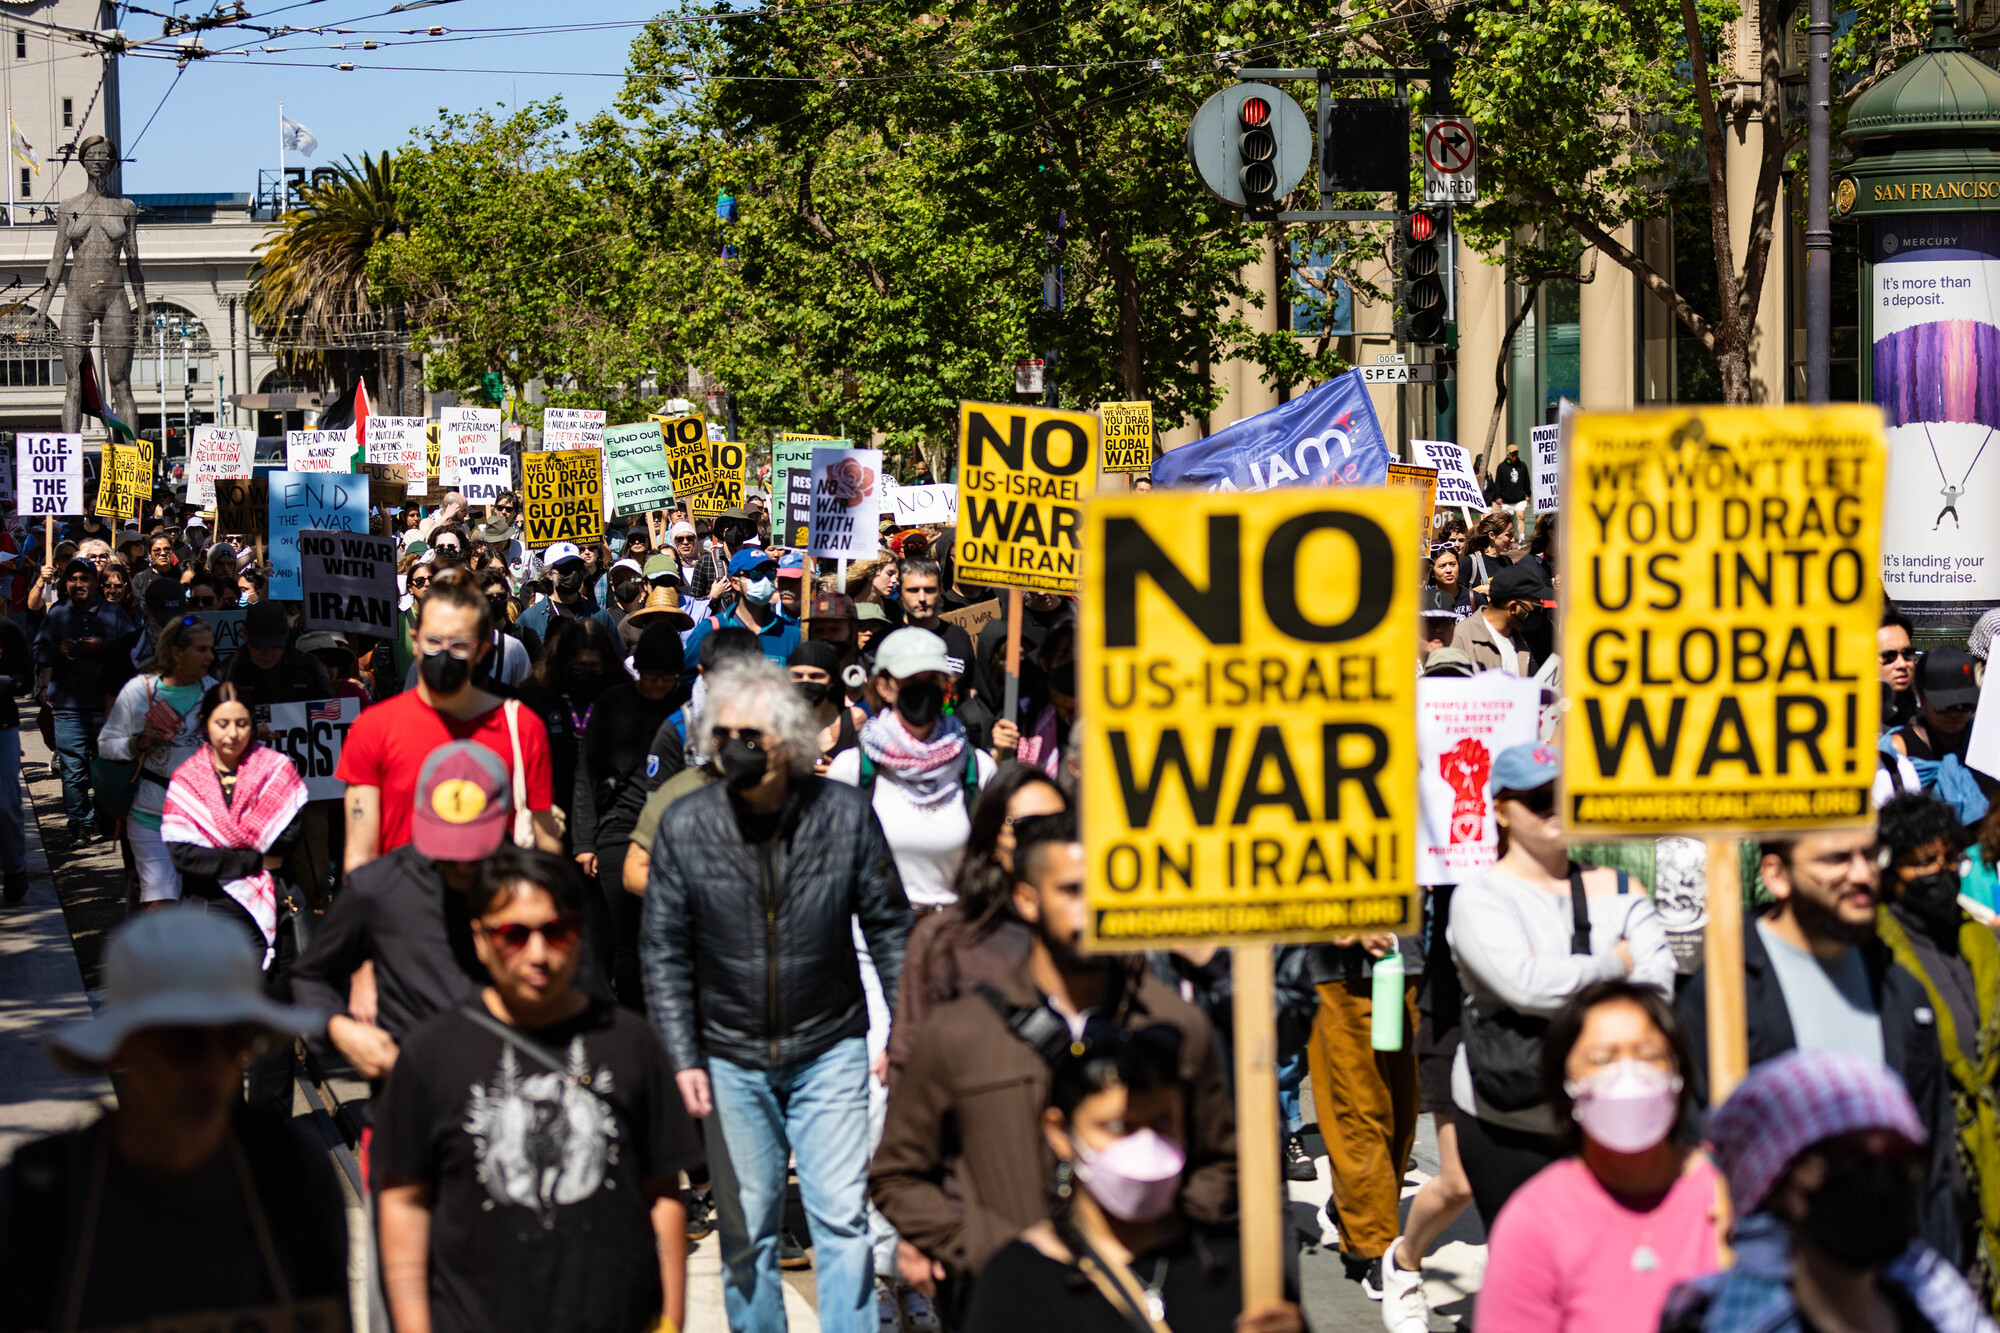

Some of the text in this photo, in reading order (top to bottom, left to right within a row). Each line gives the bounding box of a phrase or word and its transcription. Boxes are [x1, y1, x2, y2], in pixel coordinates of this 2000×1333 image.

[1429, 181, 1472, 194] ON RED
[1874, 182, 2000, 200] SAN FRANCISC
[1902, 238, 1958, 246] MERCURY
[1902, 278, 1936, 289] more
[1941, 276, 1971, 288] than
[1892, 292, 1944, 308] deposit.
[1366, 368, 1418, 380] SPEAR
[462, 410, 480, 421] U.S.
[548, 410, 564, 418] IRAN
[584, 411, 604, 419] RIGHT
[1104, 416, 1149, 424] YOU DRAG
[370, 418, 386, 429] IRAN
[407, 418, 424, 428] RIGHT
[448, 422, 499, 432] IMPERIALISM:
[552, 420, 578, 430] NUCLEAR
[1106, 424, 1149, 436] US INTO
[210, 430, 234, 440] ONLY
[291, 431, 346, 446] DEFEND IRAN
[375, 430, 405, 441] NUCLEAR
[555, 432, 580, 441] DETER
[607, 431, 660, 445] FUND OUR
[663, 418, 703, 448] NO
[28, 438, 72, 454] I.C.E.
[370, 441, 402, 452] WEAPONS
[610, 444, 662, 459] SCHOOLS
[968, 412, 1088, 476] NO
[1105, 438, 1149, 450] GLOBAL
[1539, 441, 1557, 453] PEO
[137, 442, 151, 462] NO
[196, 450, 240, 462] REVOLUTION
[308, 448, 338, 457] AGAINST
[370, 451, 423, 462] DETER ISRAEL
[1105, 450, 1149, 465] WAR!
[1425, 445, 1462, 459] STOP
[33, 456, 67, 472] OUT
[116, 461, 134, 470] DRAG
[200, 464, 240, 473] CAN STOP
[294, 459, 334, 472] CRIMINAL
[460, 457, 476, 467] NO
[480, 456, 508, 468] WAR
[526, 459, 597, 472] WE WON'T LET
[1432, 459, 1464, 473] THE
[103, 468, 134, 482] US INTO
[136, 469, 150, 486] WAR
[363, 466, 404, 480] FUCK
[470, 467, 499, 475] WITH
[527, 468, 597, 484] YOU DRAG
[615, 470, 666, 485] NOT THE
[1588, 460, 1644, 491] WE
[1804, 456, 1866, 487] LET
[33, 480, 66, 495] THE
[101, 481, 132, 496] GLOBAL
[680, 472, 711, 490] IRAN!
[817, 479, 838, 496] NO
[966, 470, 1081, 501] US-ISRAEL
[1392, 476, 1433, 489] THE TRUMP
[216, 486, 244, 506] NO
[285, 483, 348, 511] END
[528, 480, 598, 500] US INTO
[617, 485, 670, 499] PENTAGON
[33, 497, 68, 513] BAY
[100, 492, 132, 512] WAR!
[529, 499, 598, 518] GLOBAL
[694, 499, 709, 509] ON
[817, 498, 848, 514] WAR
[897, 490, 934, 515] NO
[277, 514, 352, 532] THE WAR
[529, 514, 600, 539] WAR!
[816, 516, 854, 532] WITH
[966, 496, 1082, 550] WAR
[1591, 494, 1862, 544] YOU DRAG
[814, 534, 852, 550] IRAN
[304, 537, 393, 563] NO WAR
[962, 542, 998, 564] ON
[323, 558, 375, 579] WITH
[1902, 554, 1951, 570] landing
[1955, 557, 1984, 569] your
[276, 569, 292, 578] AND
[1104, 508, 1396, 648] NO
[1592, 548, 1864, 614] US INTO
[1884, 570, 1976, 583] first fundraise.
[309, 592, 391, 628] IRAN
[972, 611, 993, 624] WAR
[1586, 625, 1860, 686] GLOBAL
[1102, 653, 1392, 711] US-ISRAEL
[1584, 693, 1858, 778] WAR!
[1107, 722, 1392, 828] WAR
[1106, 833, 1400, 894] ON IRAN!
